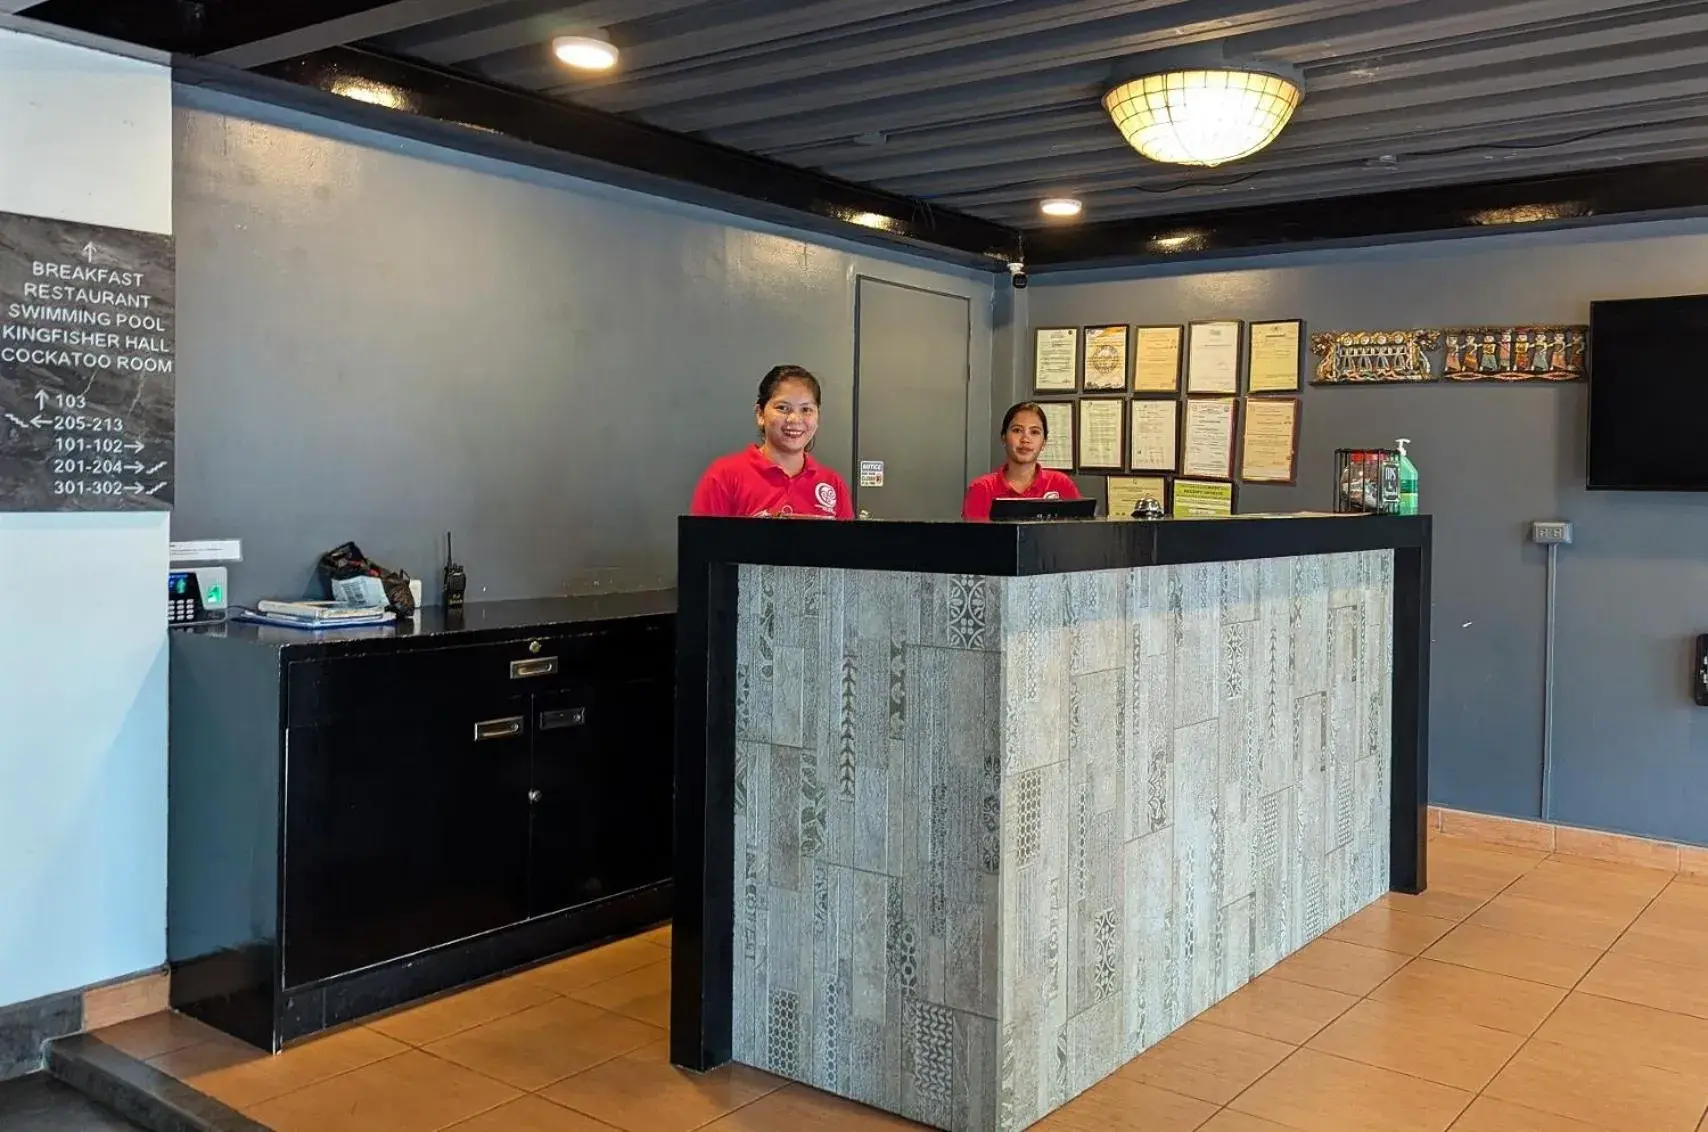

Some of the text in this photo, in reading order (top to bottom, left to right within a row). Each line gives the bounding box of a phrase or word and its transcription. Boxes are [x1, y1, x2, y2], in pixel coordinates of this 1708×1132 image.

[33, 261, 144, 286] BREAKFAST
[24, 283, 151, 308] RESTAURANT
[8, 303, 165, 332] SWIMMING POOL
[1, 324, 169, 353] KINGFISHER HALL
[1, 347, 173, 373] COCKATOO ROOM
[55, 393, 87, 409] 103
[54, 416, 124, 432] 205-213
[55, 437, 123, 453] 101-102
[54, 459, 123, 474] 201-204
[54, 480, 123, 495] 301-302
